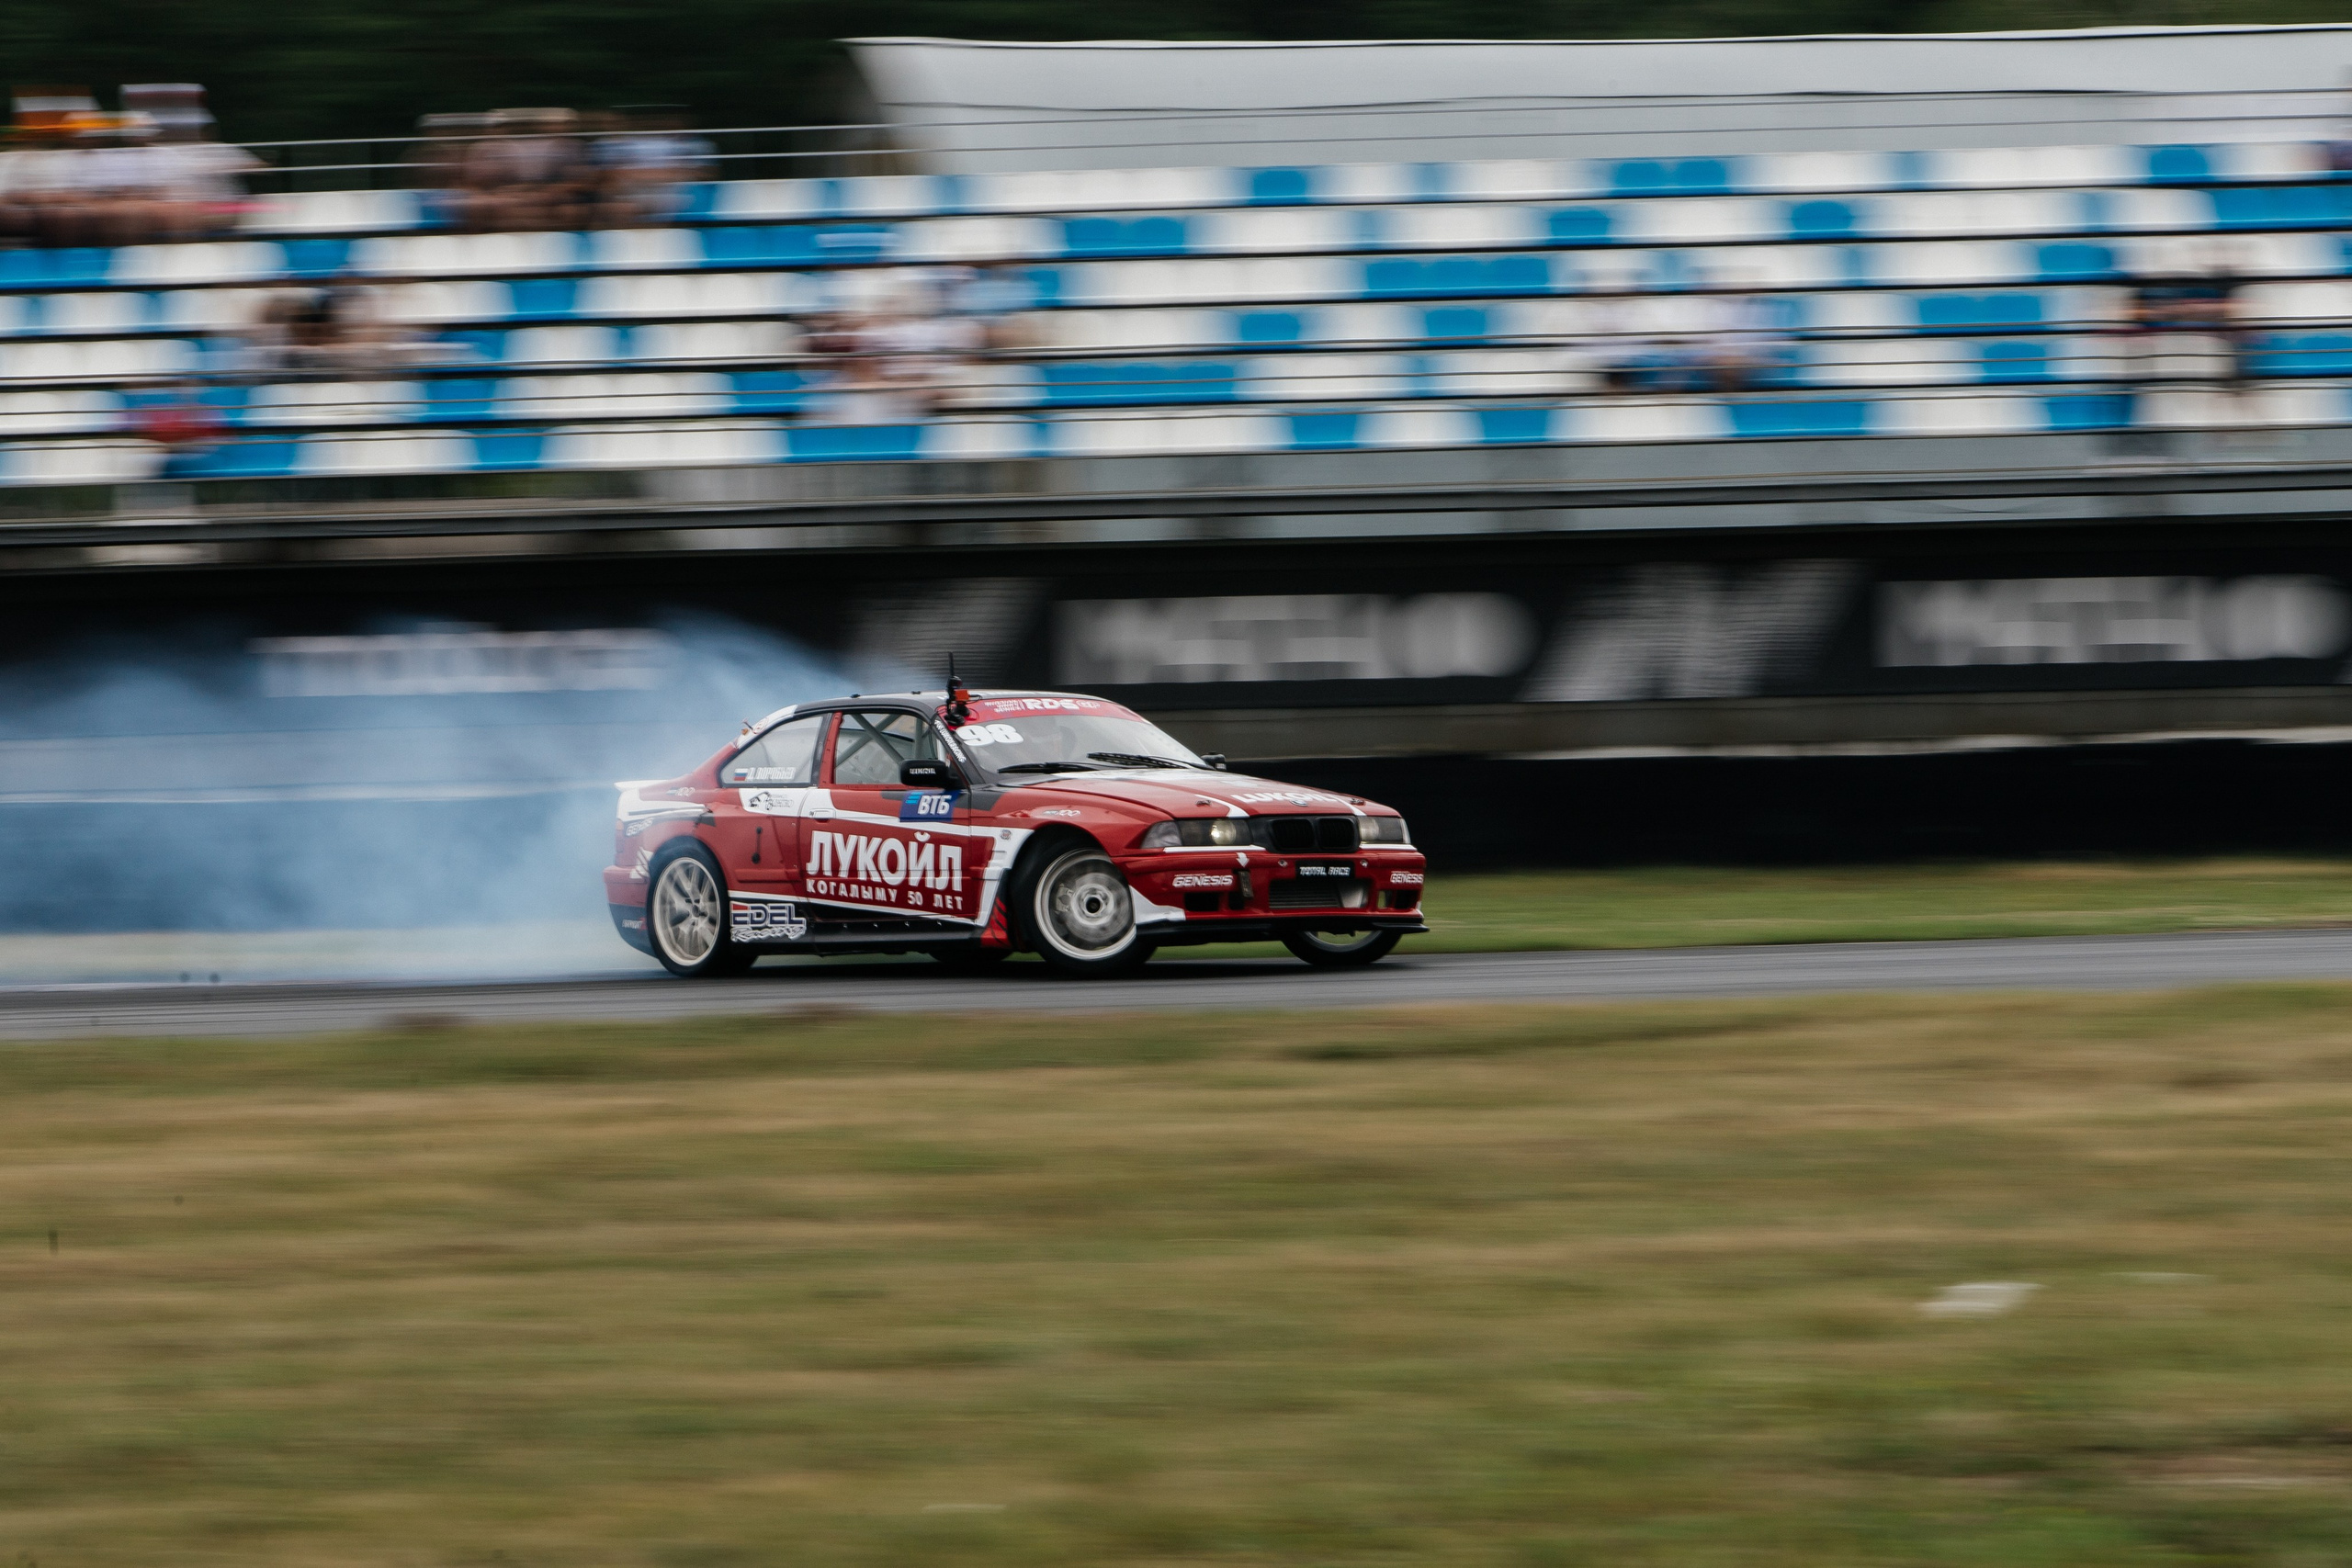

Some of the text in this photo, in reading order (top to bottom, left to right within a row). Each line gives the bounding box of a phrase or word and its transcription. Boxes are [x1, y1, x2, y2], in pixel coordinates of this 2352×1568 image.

[1022, 698, 1080, 710] RDS
[956, 723, 1024, 746] 98
[917, 795, 952, 816] ВТБ
[1230, 792, 1339, 804] LUKOIL
[806, 830, 963, 892] ЛУКОЙЛ
[1171, 874, 1233, 888] GENESIS
[806, 878, 963, 910] КОГАЛЫМУ 50 ЛЕТ
[730, 901, 807, 927] EDEL
